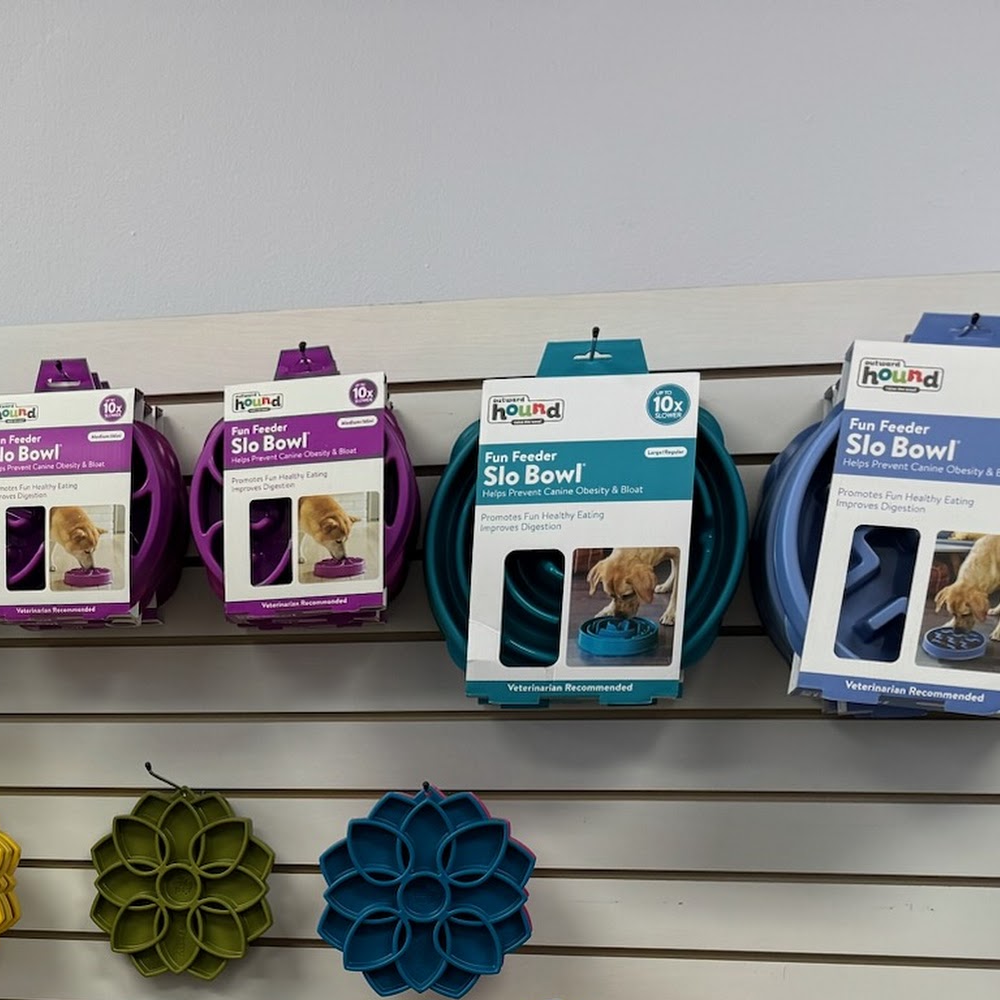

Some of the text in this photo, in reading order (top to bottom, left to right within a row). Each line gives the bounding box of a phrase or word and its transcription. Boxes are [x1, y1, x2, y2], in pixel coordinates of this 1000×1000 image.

[862, 366, 939, 388] hound
[353, 387, 374, 399] 10x
[103, 402, 122, 414] 10x
[235, 396, 281, 411] hound
[492, 402, 560, 421] hound
[653, 396, 683, 413] 10x
[232, 423, 287, 436] Fun Feeder
[850, 418, 930, 435] Fun Feeder
[9, 434, 41, 444] Feeder
[231, 432, 308, 455] Slo Bowl
[19, 444, 59, 462] Bowl
[846, 433, 956, 462] Slo Bowl
[485, 450, 557, 463] Fun Feeder
[483, 463, 582, 487] Slo Bowl
[843, 458, 869, 469] Helps
[871, 461, 909, 471] Prevent
[911, 462, 944, 473] Canine
[946, 465, 984, 478] Obesity
[986, 468, 993, 476] &
[482, 486, 643, 498] Helps Prevent Canine Obesity & Bloat
[481, 511, 604, 522] Promotes Fun Healthy Eating
[480, 522, 561, 533] Improves Digestion
[507, 683, 633, 693] Veterinarian Recommended
[845, 680, 985, 703] Veterinarian Recommended
